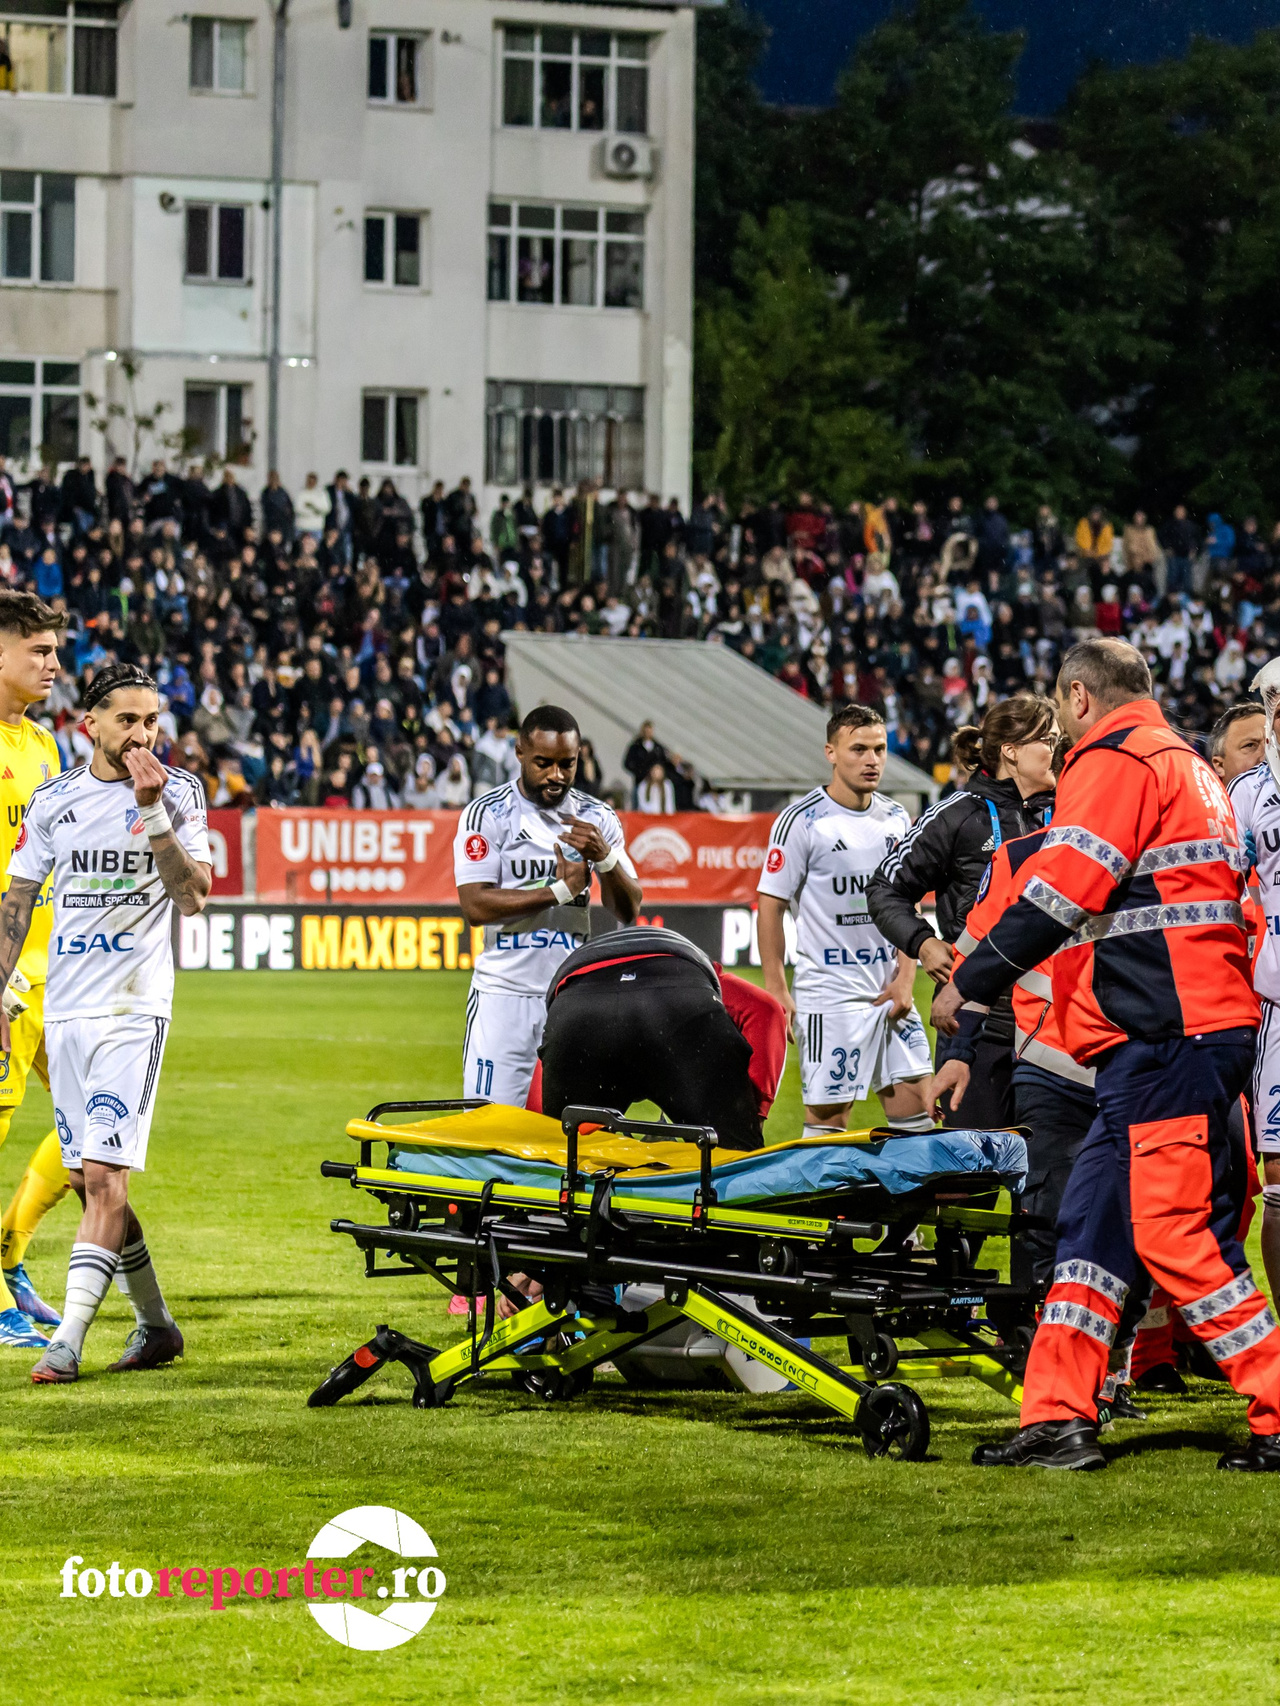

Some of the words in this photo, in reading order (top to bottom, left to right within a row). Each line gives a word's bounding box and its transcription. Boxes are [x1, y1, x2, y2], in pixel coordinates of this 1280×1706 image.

[281, 819, 434, 862] UNIBET
[697, 846, 733, 869] FIVE
[179, 913, 234, 970] DE
[242, 913, 294, 970] PE
[476, 1058, 494, 1096] 11
[830, 1047, 861, 1081] 33
[951, 1296, 984, 1305] KARTSANA
